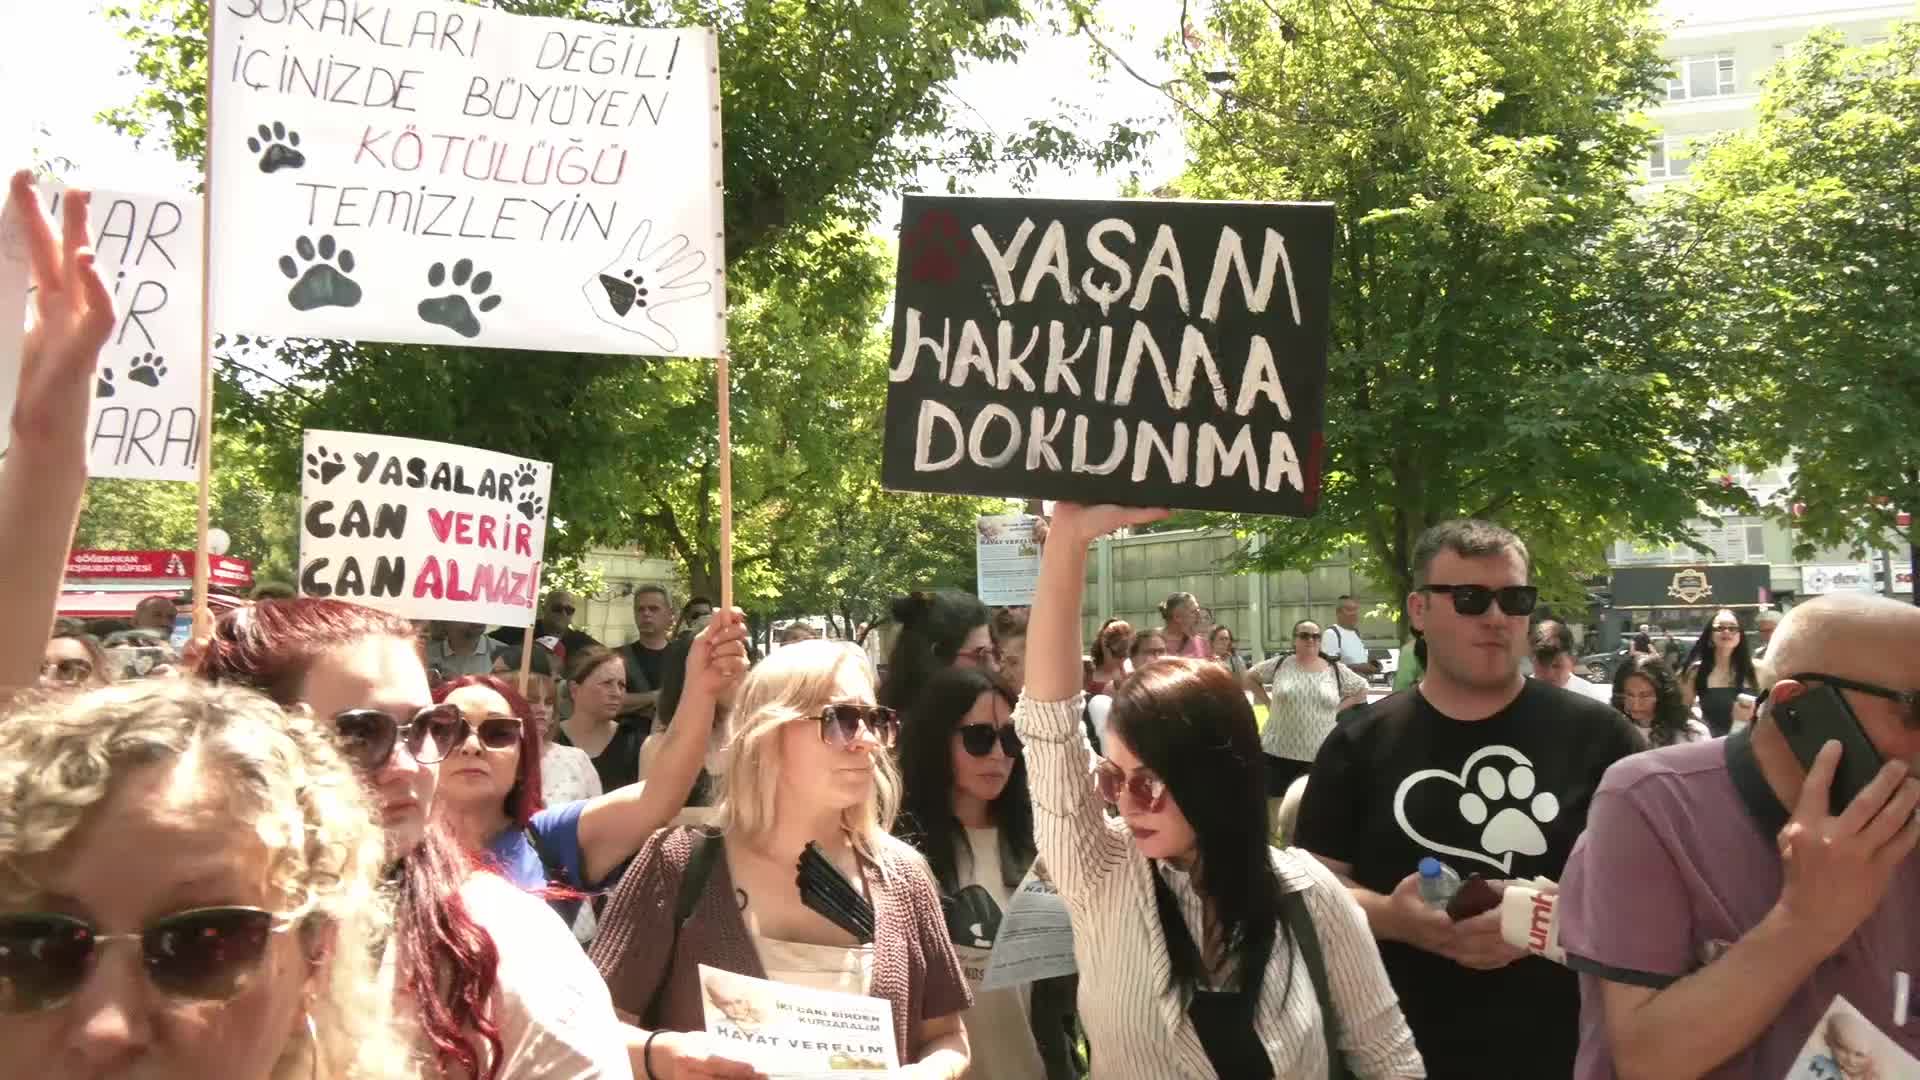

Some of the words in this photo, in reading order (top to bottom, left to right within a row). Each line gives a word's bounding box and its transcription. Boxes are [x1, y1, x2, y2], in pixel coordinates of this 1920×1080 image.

[232, 35, 425, 112] İÇİNİZDE
[463, 76, 669, 127] BÜYÜYEN
[536, 31, 680, 80] DEĞİL!
[354, 124, 628, 185] KÖTÜLÜĞÜ
[295, 182, 618, 241] TEMİZLEYİN
[971, 216, 1302, 326] YAŞAM
[914, 399, 1304, 493] DOKUNMA
[353, 451, 514, 503] YASALAR
[305, 500, 408, 540] CAN
[427, 507, 532, 558] VERİR
[300, 555, 406, 598] CAN
[412, 555, 541, 609] ALMAZ!
[717, 1025, 780, 1046] HAYAT
